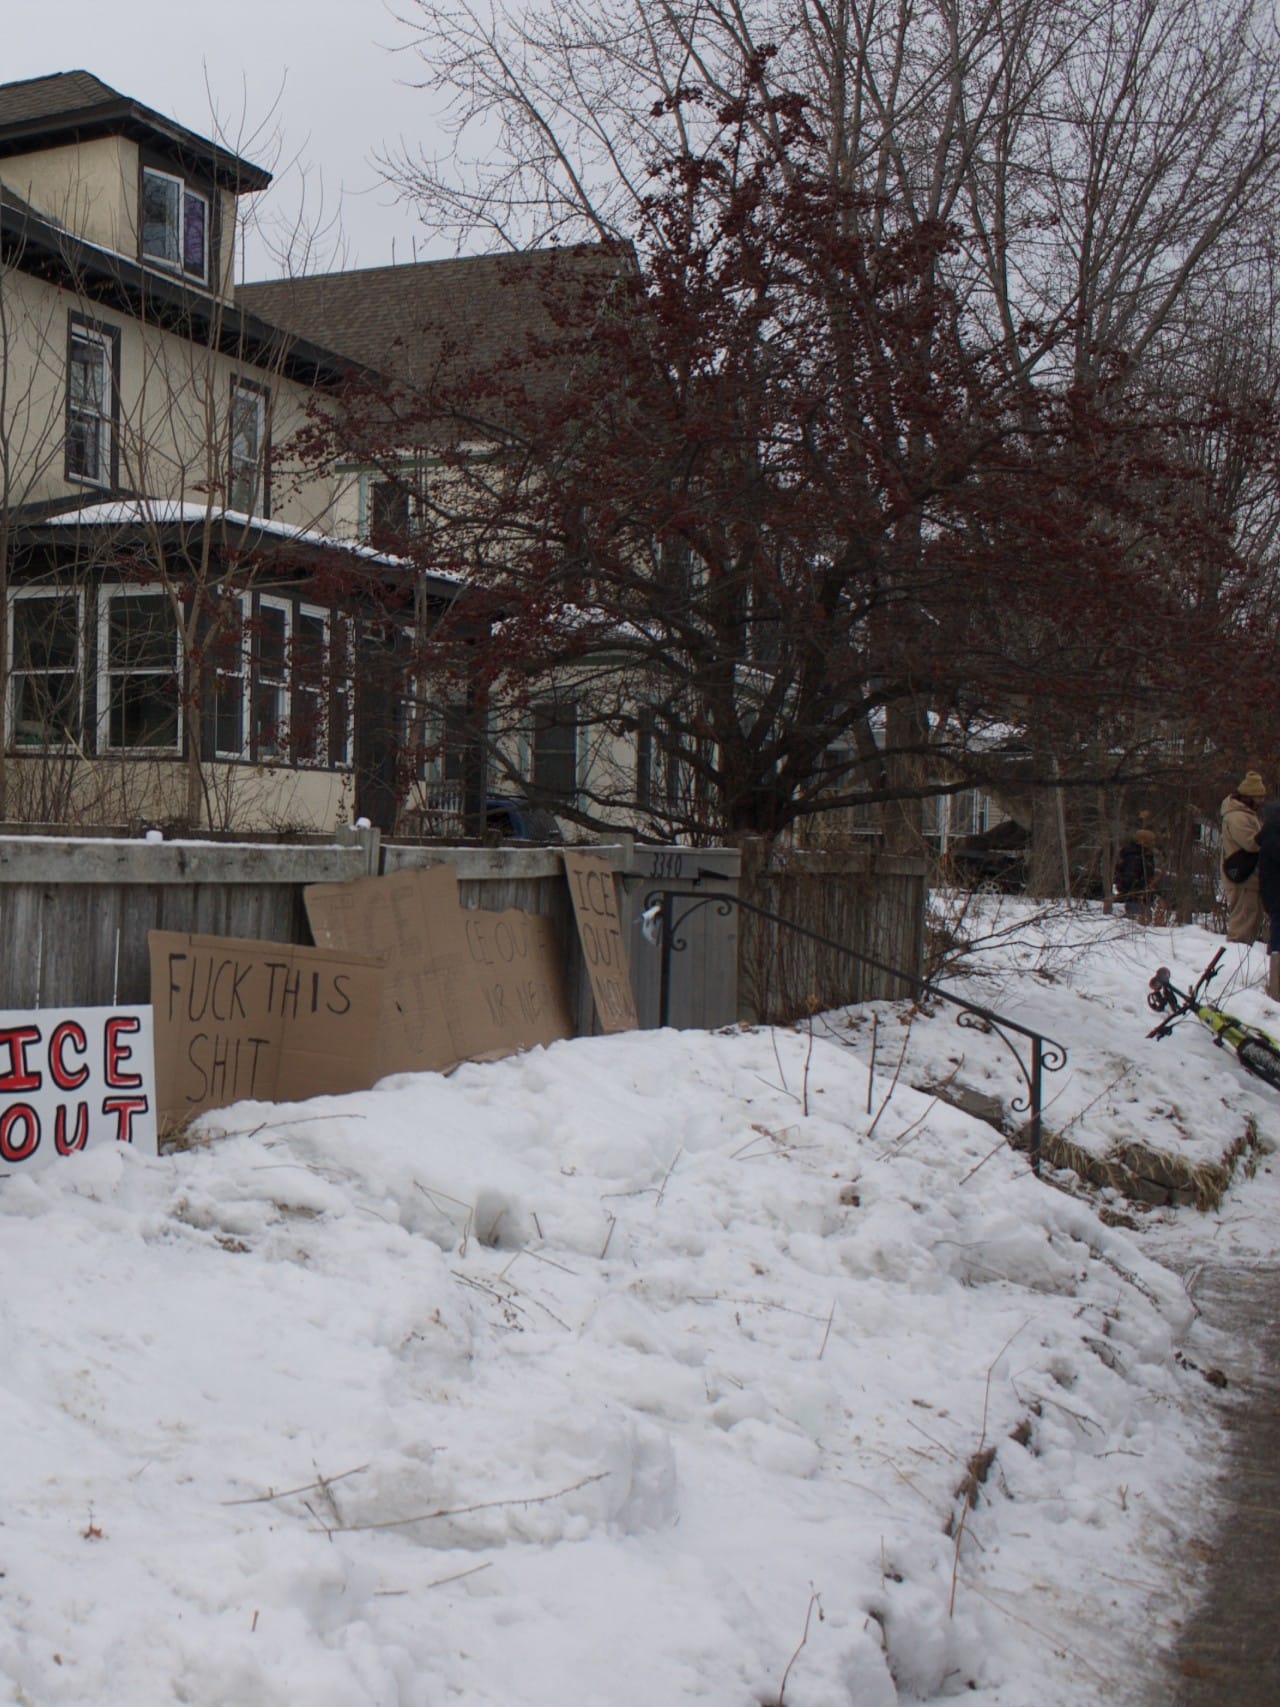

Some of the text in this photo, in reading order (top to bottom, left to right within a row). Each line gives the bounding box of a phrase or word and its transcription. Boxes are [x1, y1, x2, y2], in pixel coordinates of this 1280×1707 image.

[573, 869, 616, 918] ICE
[582, 921, 621, 970] OUT
[167, 952, 352, 1023] FUCK THIS
[185, 1032, 270, 1104] SHIT
